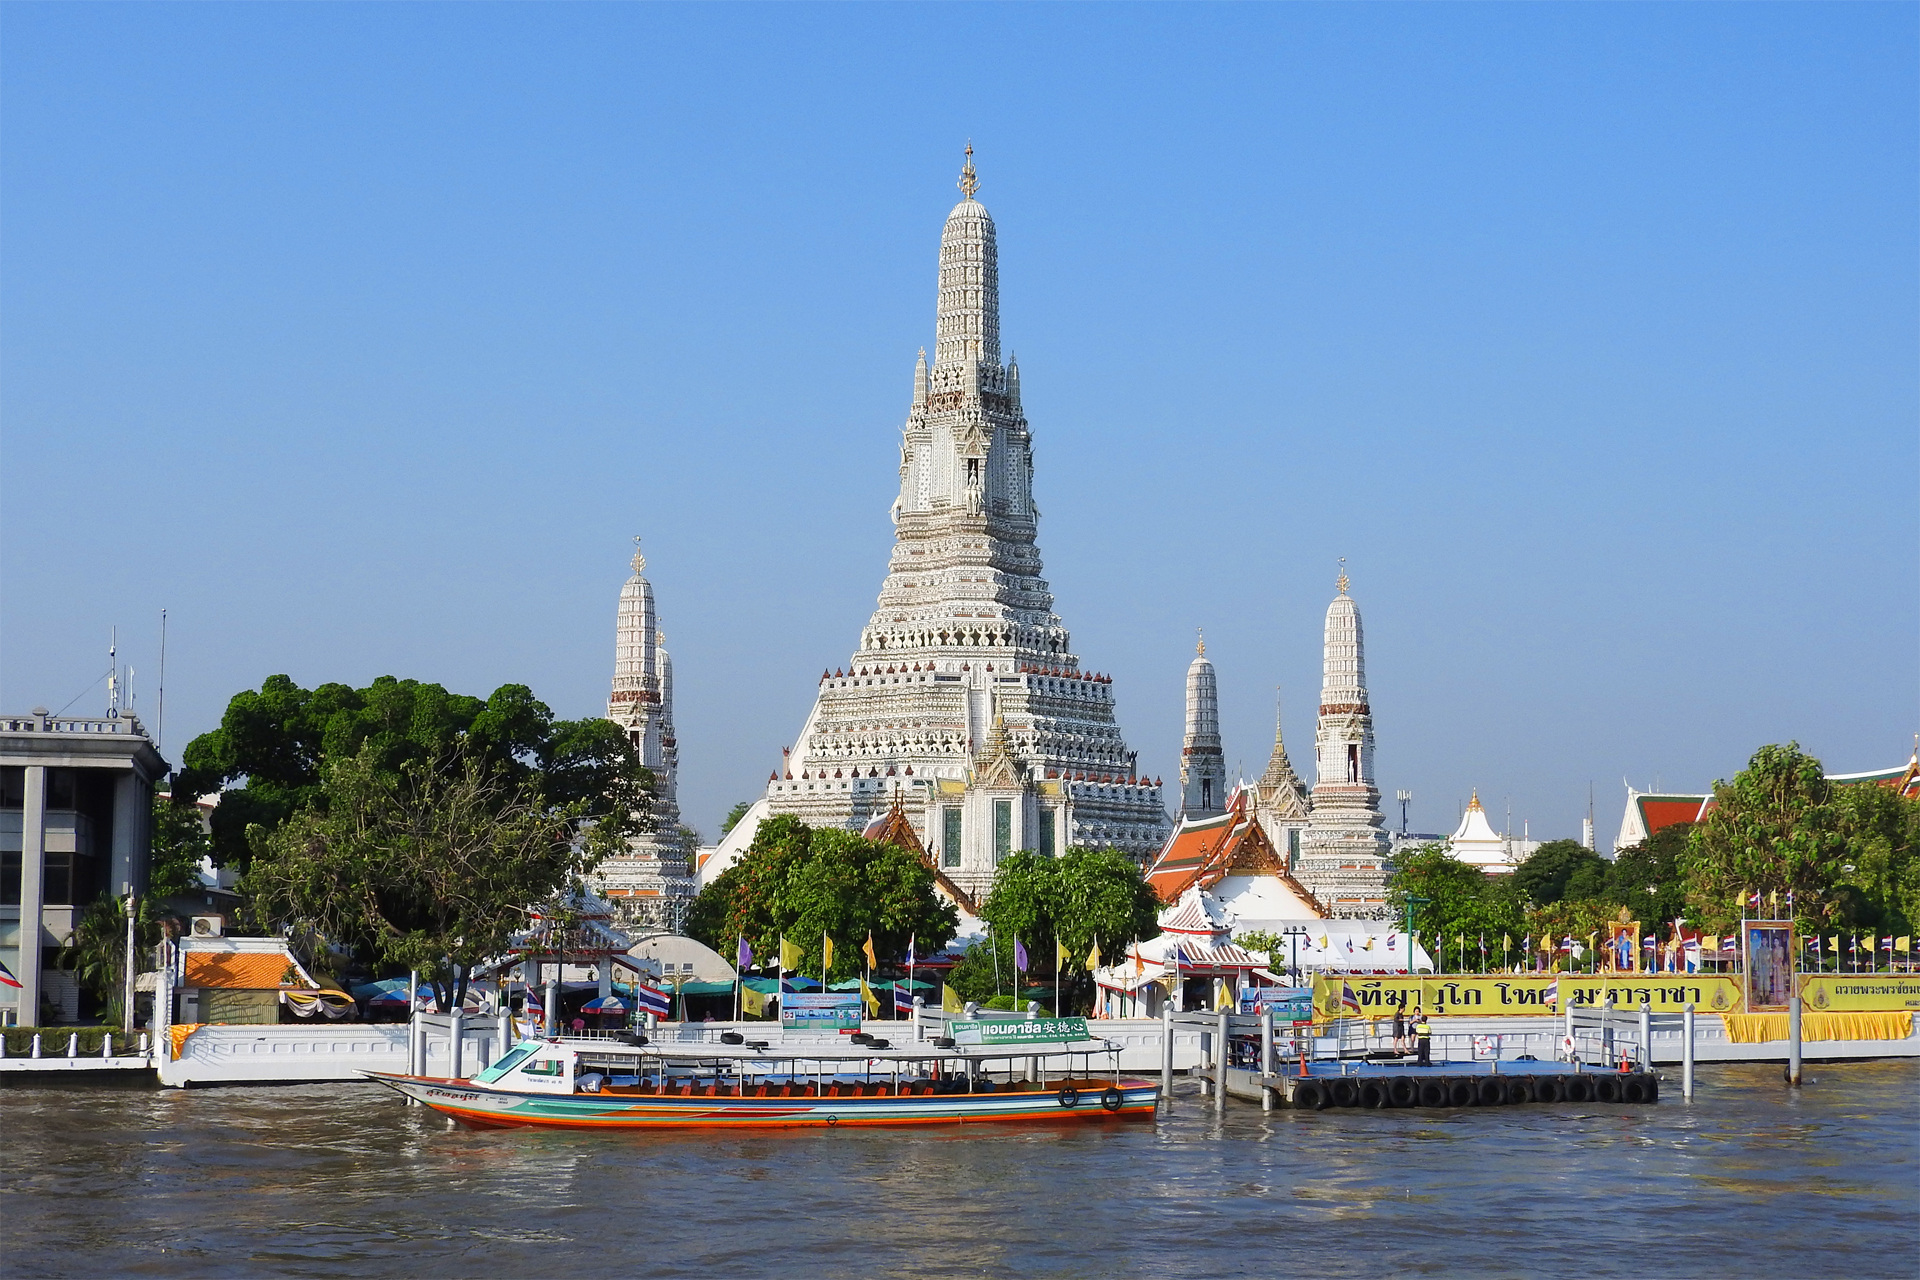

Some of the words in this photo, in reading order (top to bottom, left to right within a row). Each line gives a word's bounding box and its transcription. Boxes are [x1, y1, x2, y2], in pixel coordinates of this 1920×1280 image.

[982, 1022, 1042, 1035] แอนตาซิล
[1042, 1021, 1084, 1034] 安德心
